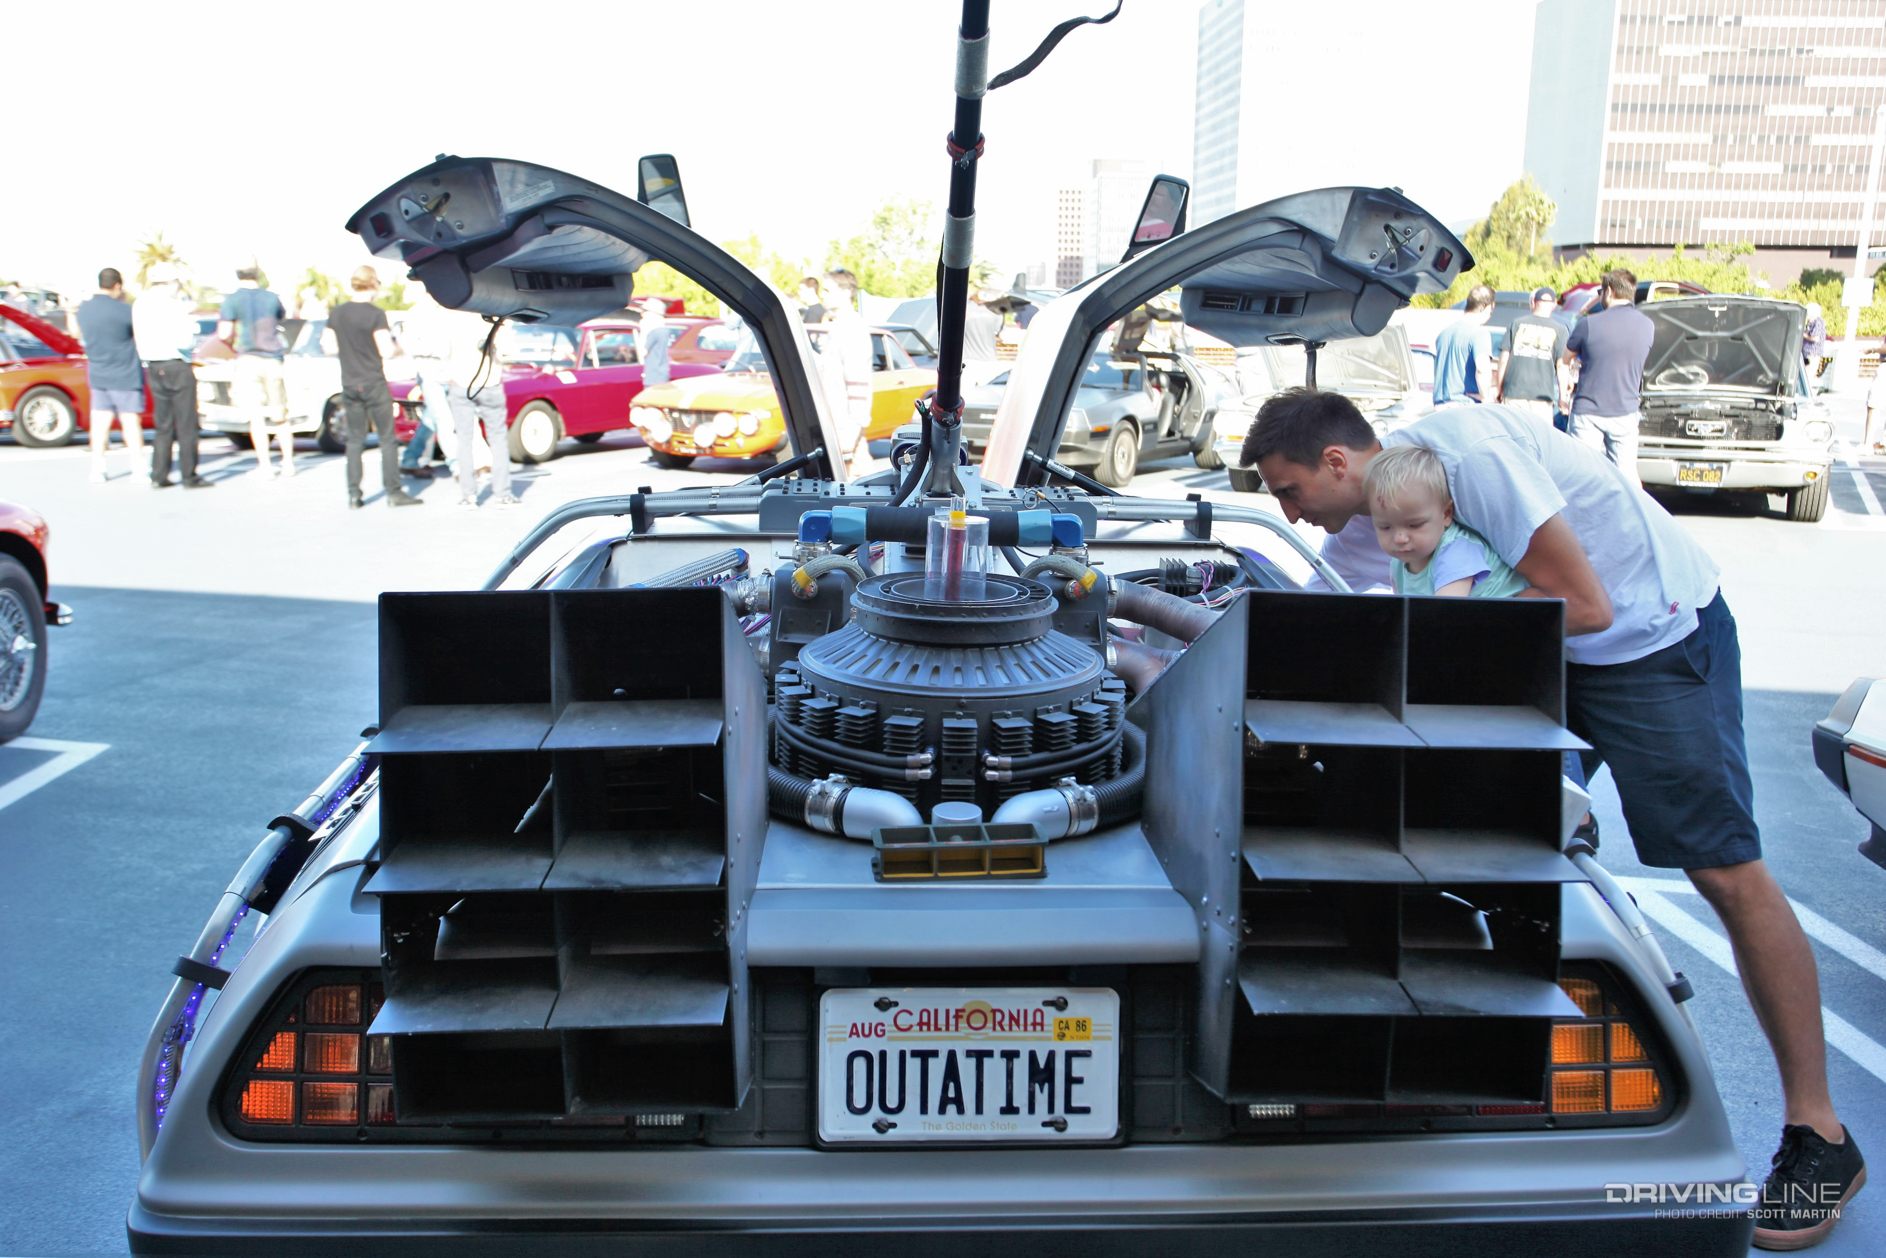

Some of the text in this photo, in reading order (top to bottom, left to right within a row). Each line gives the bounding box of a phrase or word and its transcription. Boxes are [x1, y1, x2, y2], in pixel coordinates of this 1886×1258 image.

[893, 1008, 1044, 1032] CALIFORNIA
[1058, 1020, 1087, 1032] CA 86
[848, 1022, 886, 1038] AUG
[846, 1049, 1092, 1115] OUTATIME
[921, 1121, 1018, 1131] The Golden State
